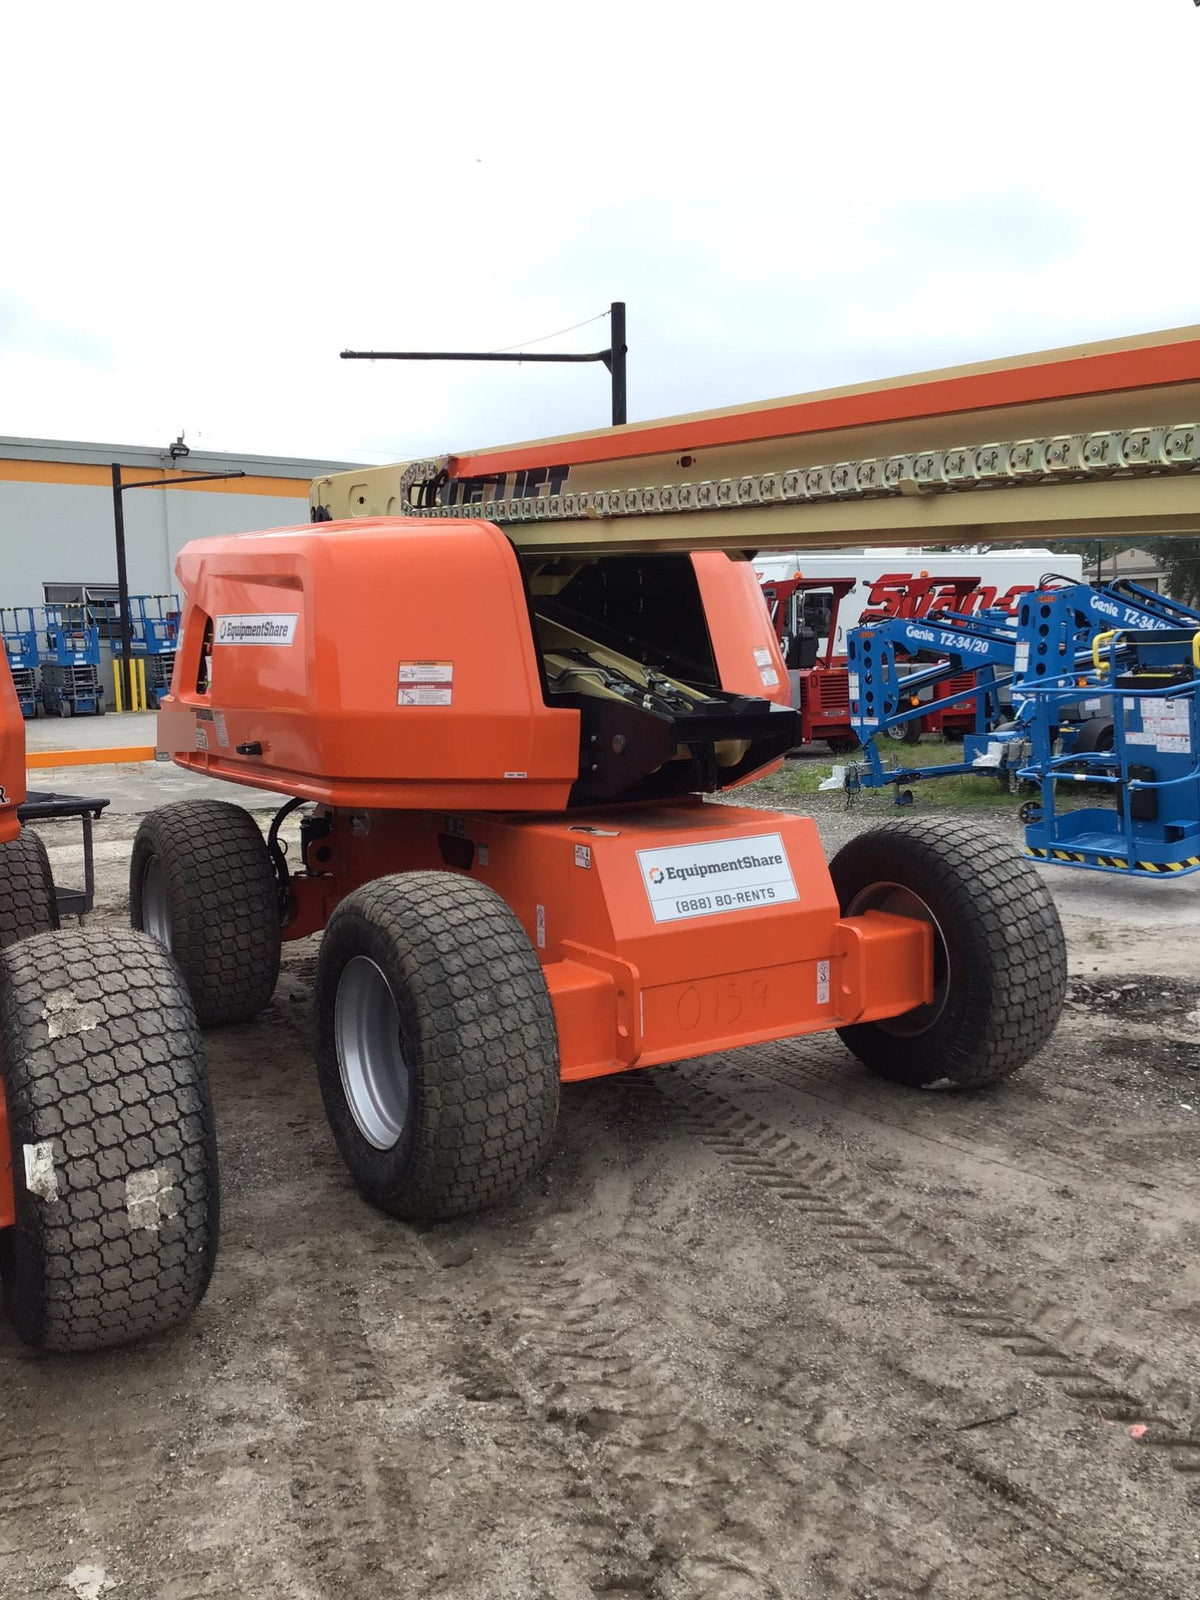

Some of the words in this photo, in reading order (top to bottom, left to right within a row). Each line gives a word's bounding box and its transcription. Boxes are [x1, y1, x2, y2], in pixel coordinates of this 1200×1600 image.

[1090, 595, 1118, 617] Genie
[226, 621, 289, 640] EquipmentShare
[906, 626, 935, 642] Genie
[940, 632, 989, 654] TZ-34/20
[665, 854, 783, 881] EquipmentShare
[676, 896, 712, 914] (888)
[715, 887, 776, 907] 80-RENTS
